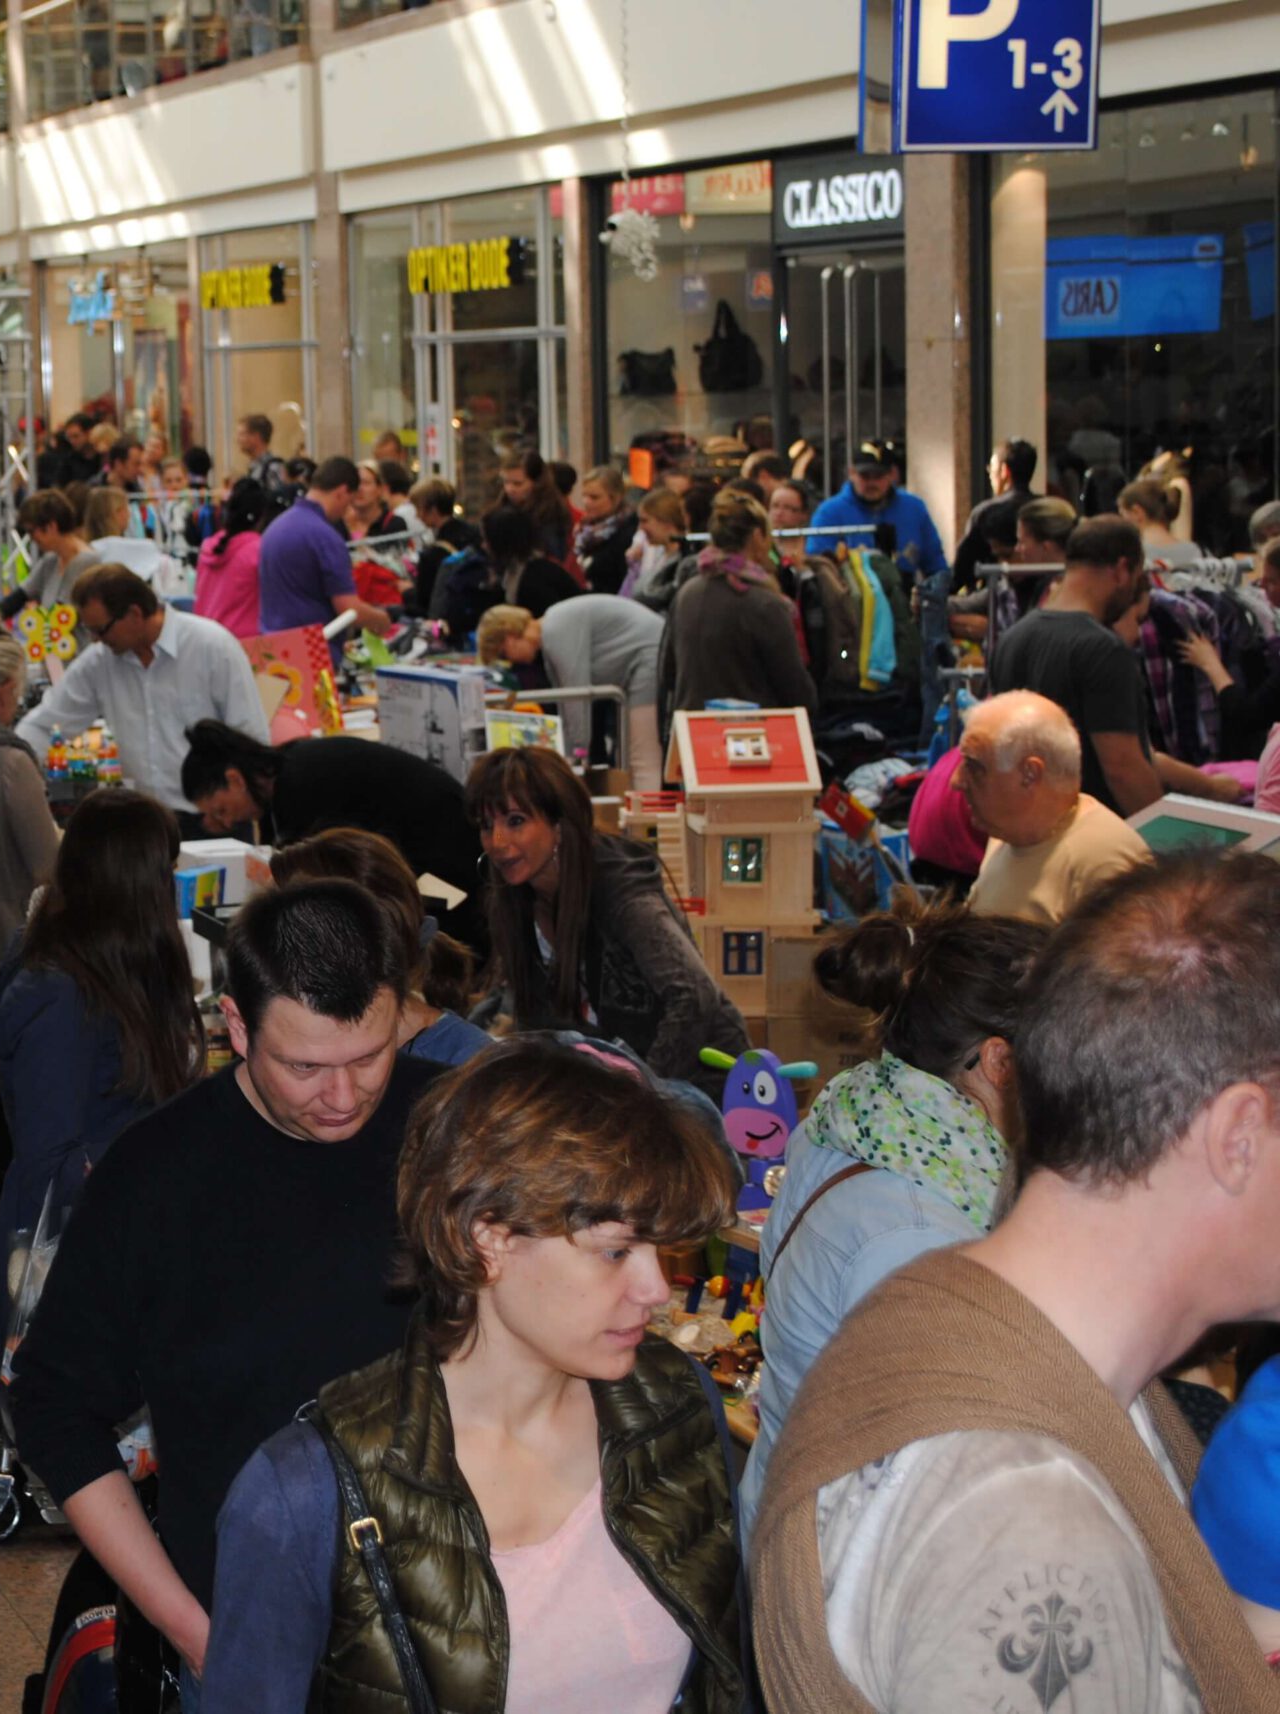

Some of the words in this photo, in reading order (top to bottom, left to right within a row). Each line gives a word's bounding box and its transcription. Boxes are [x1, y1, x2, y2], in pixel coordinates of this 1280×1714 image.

[1008, 38, 1083, 90] 1-3
[783, 169, 902, 229] CLASSICO
[408, 242, 468, 296] OPTIKER
[470, 235, 511, 290] BODE
